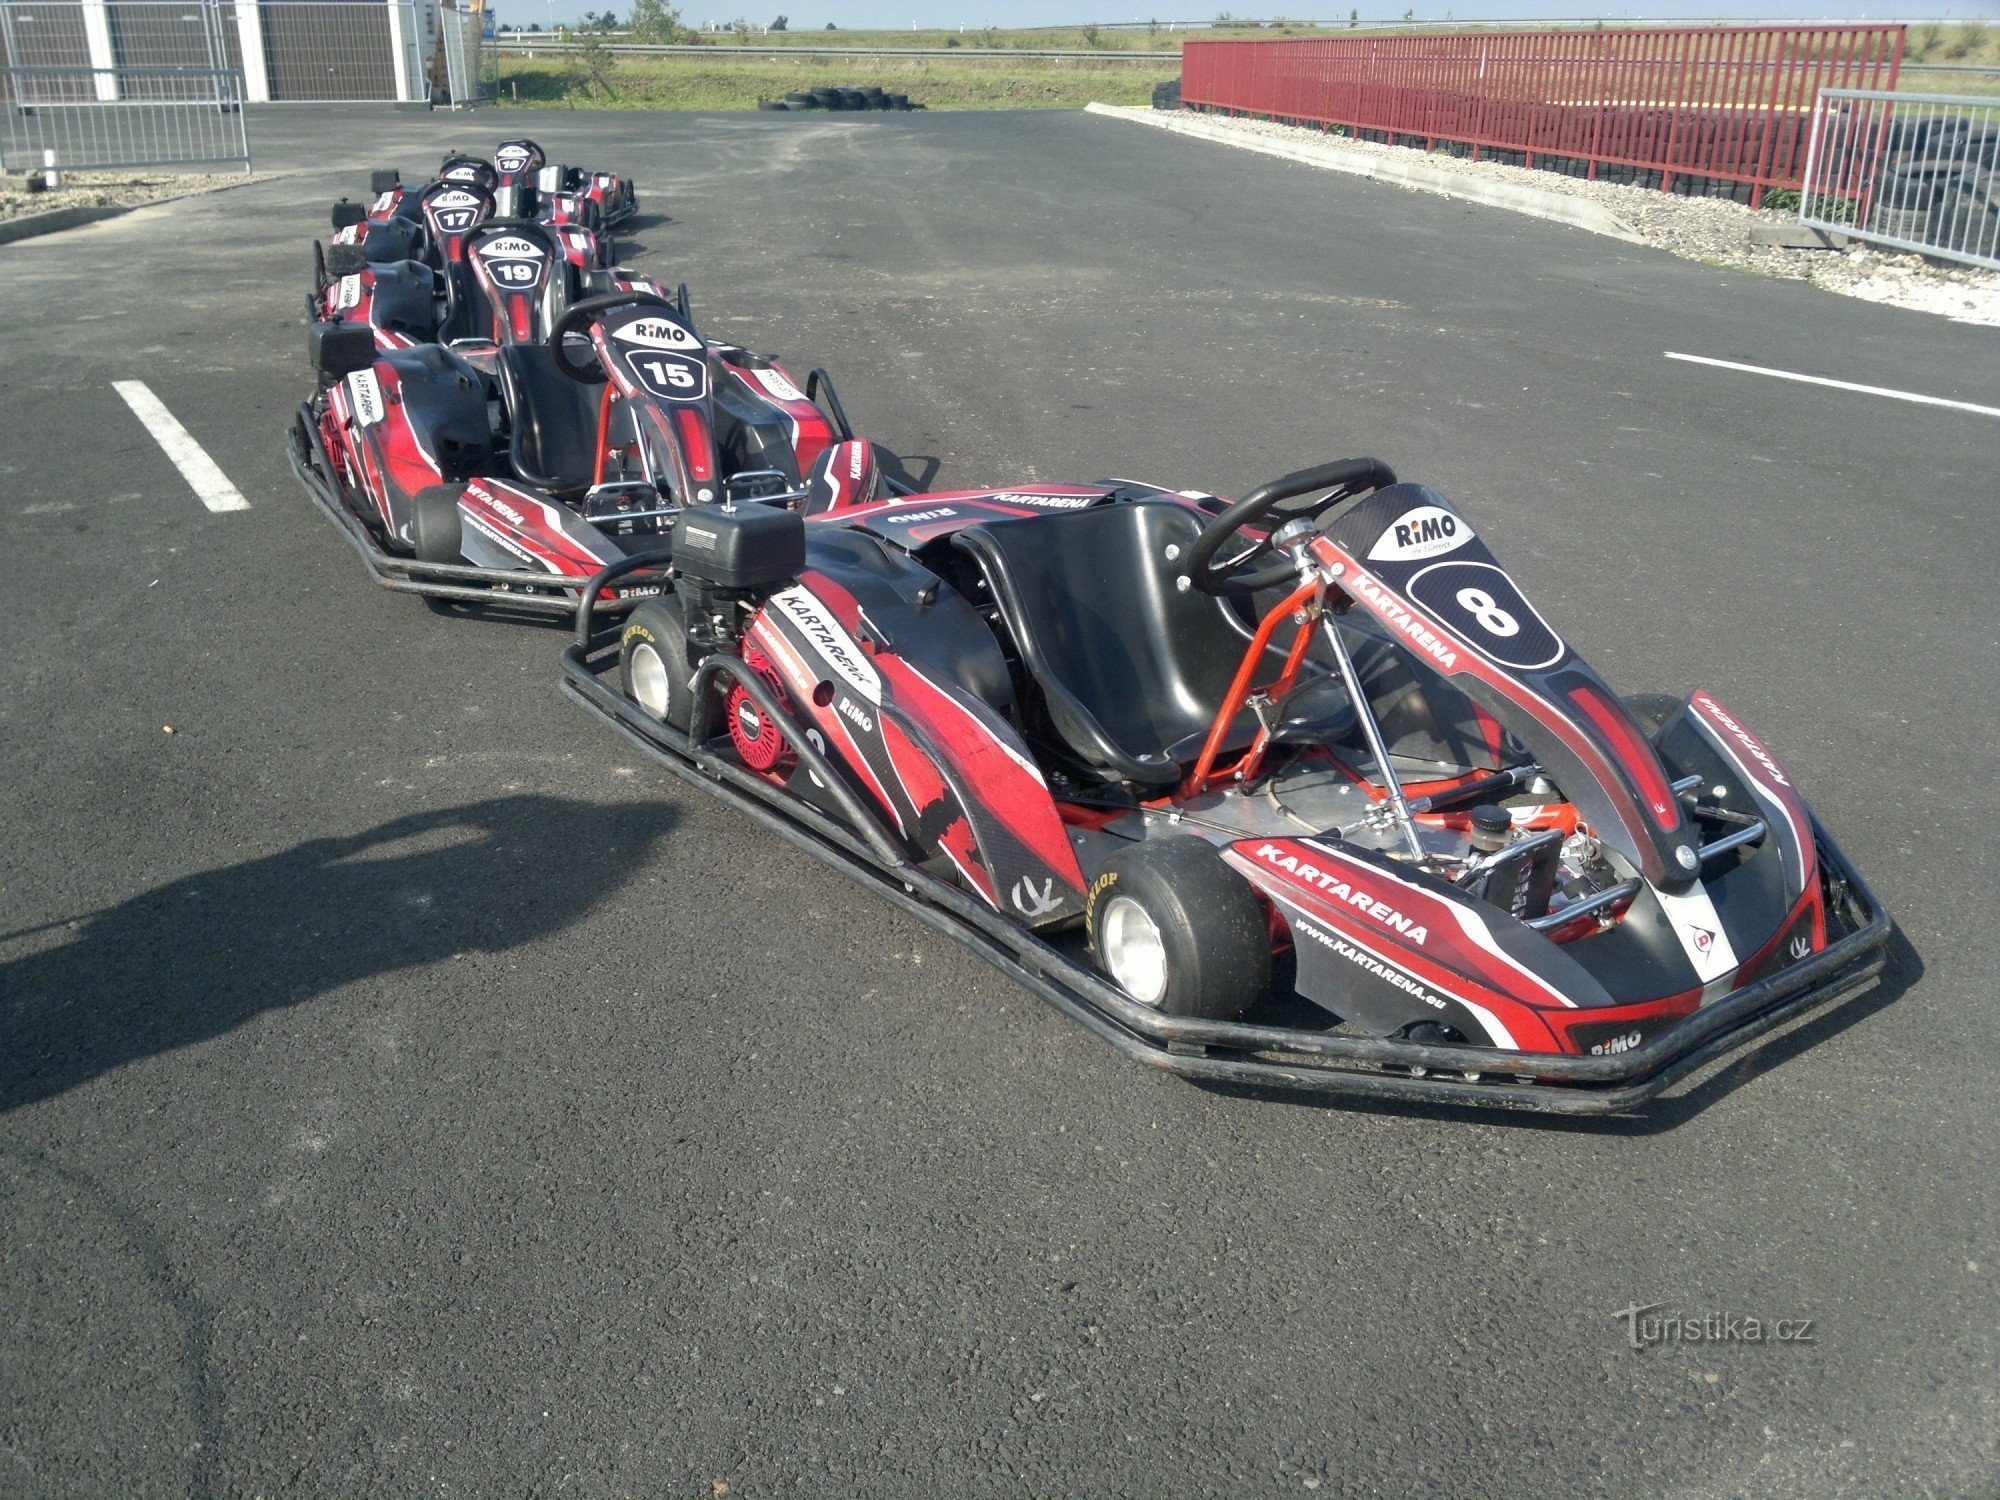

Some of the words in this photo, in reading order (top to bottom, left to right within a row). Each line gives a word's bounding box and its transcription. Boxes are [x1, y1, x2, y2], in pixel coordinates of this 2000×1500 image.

[443, 212, 469, 227] 17
[497, 265, 532, 280] 19
[635, 323, 686, 342] RiMO
[643, 361, 695, 388] 15
[993, 493, 1091, 509] KARTARENA
[1395, 515, 1457, 548] RiMO
[1350, 574, 1457, 669] KARTARENA
[1456, 587, 1520, 637] 8
[839, 697, 873, 732] RiMO
[1697, 697, 1791, 787] KARTARENA
[1086, 872, 1118, 935] DUNLOP
[1256, 844, 1429, 946] KARTARENA
[1295, 917, 1447, 1010] www.KARTARENA.eu
